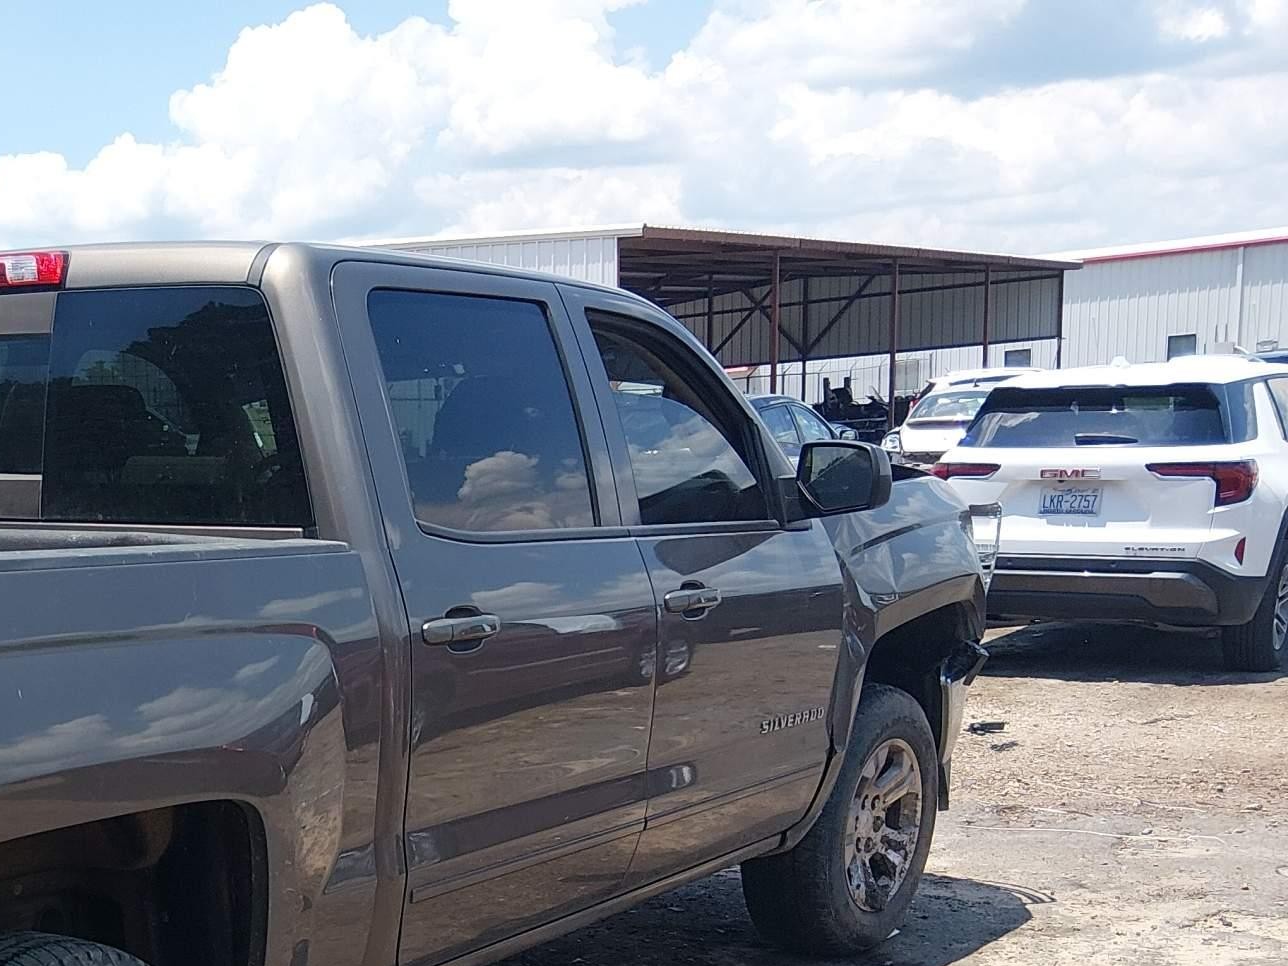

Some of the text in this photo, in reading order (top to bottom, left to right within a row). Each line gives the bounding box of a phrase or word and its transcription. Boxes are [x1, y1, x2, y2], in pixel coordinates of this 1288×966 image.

[1039, 468, 1101, 479] GMC
[1041, 494, 1099, 509] LKR-2757
[760, 706, 825, 734] SILVERADO
